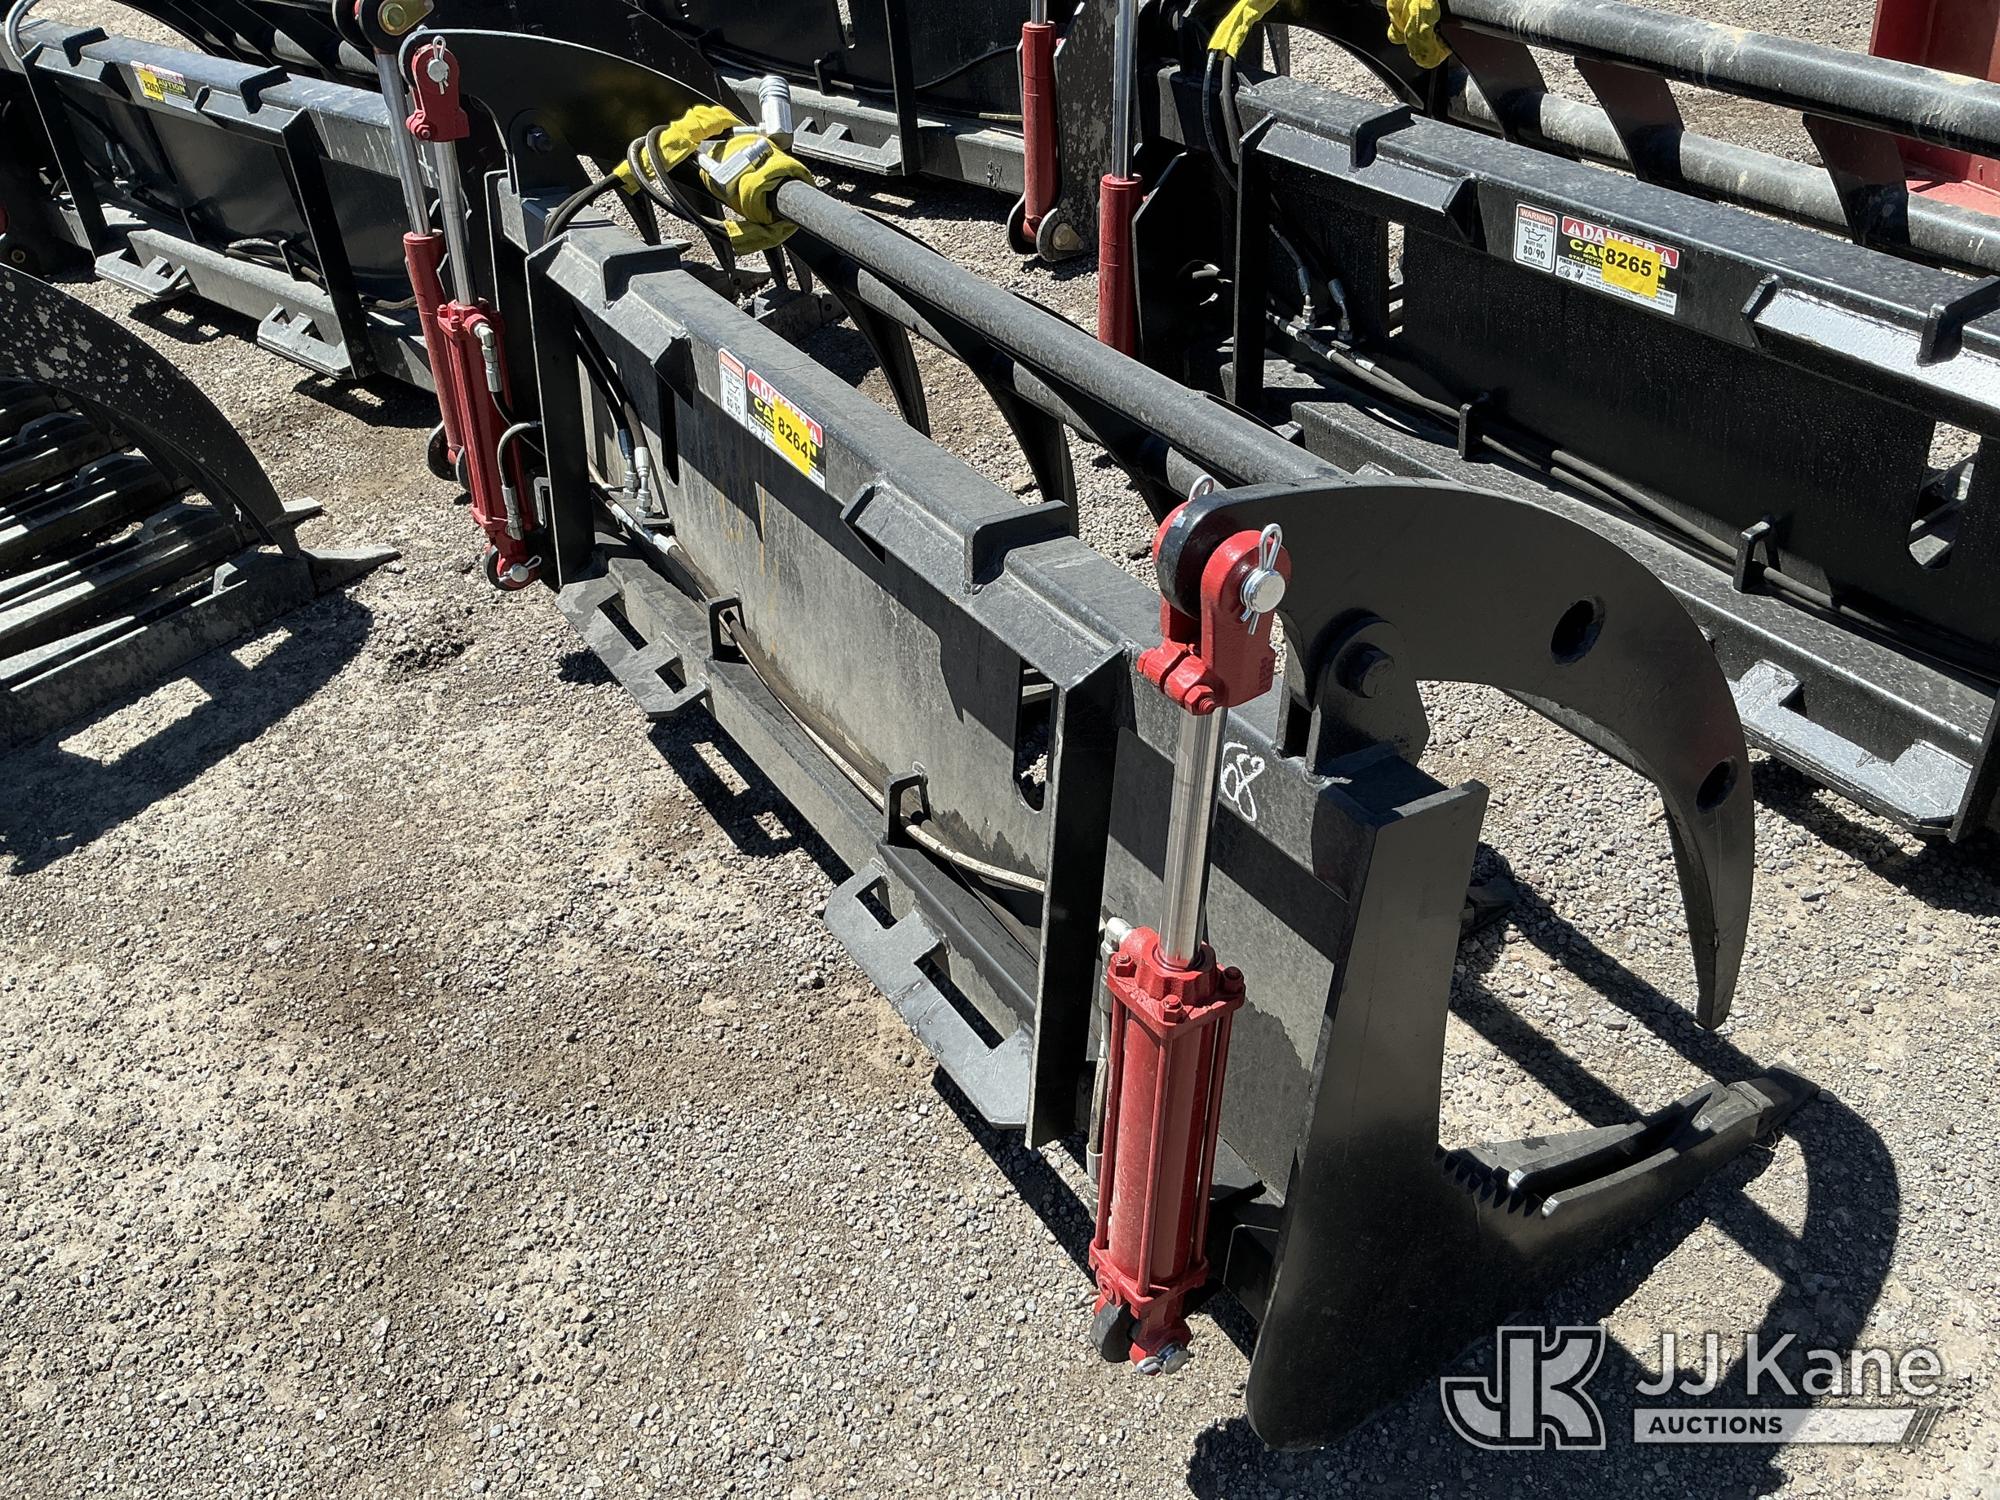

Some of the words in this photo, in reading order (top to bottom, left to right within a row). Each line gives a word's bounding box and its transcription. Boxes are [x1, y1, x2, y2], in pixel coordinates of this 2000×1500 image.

[1519, 208, 1553, 225] WARNING
[1523, 245, 1546, 260] 80/90
[1605, 248, 1652, 277] 8265
[778, 416, 809, 459] 8264
